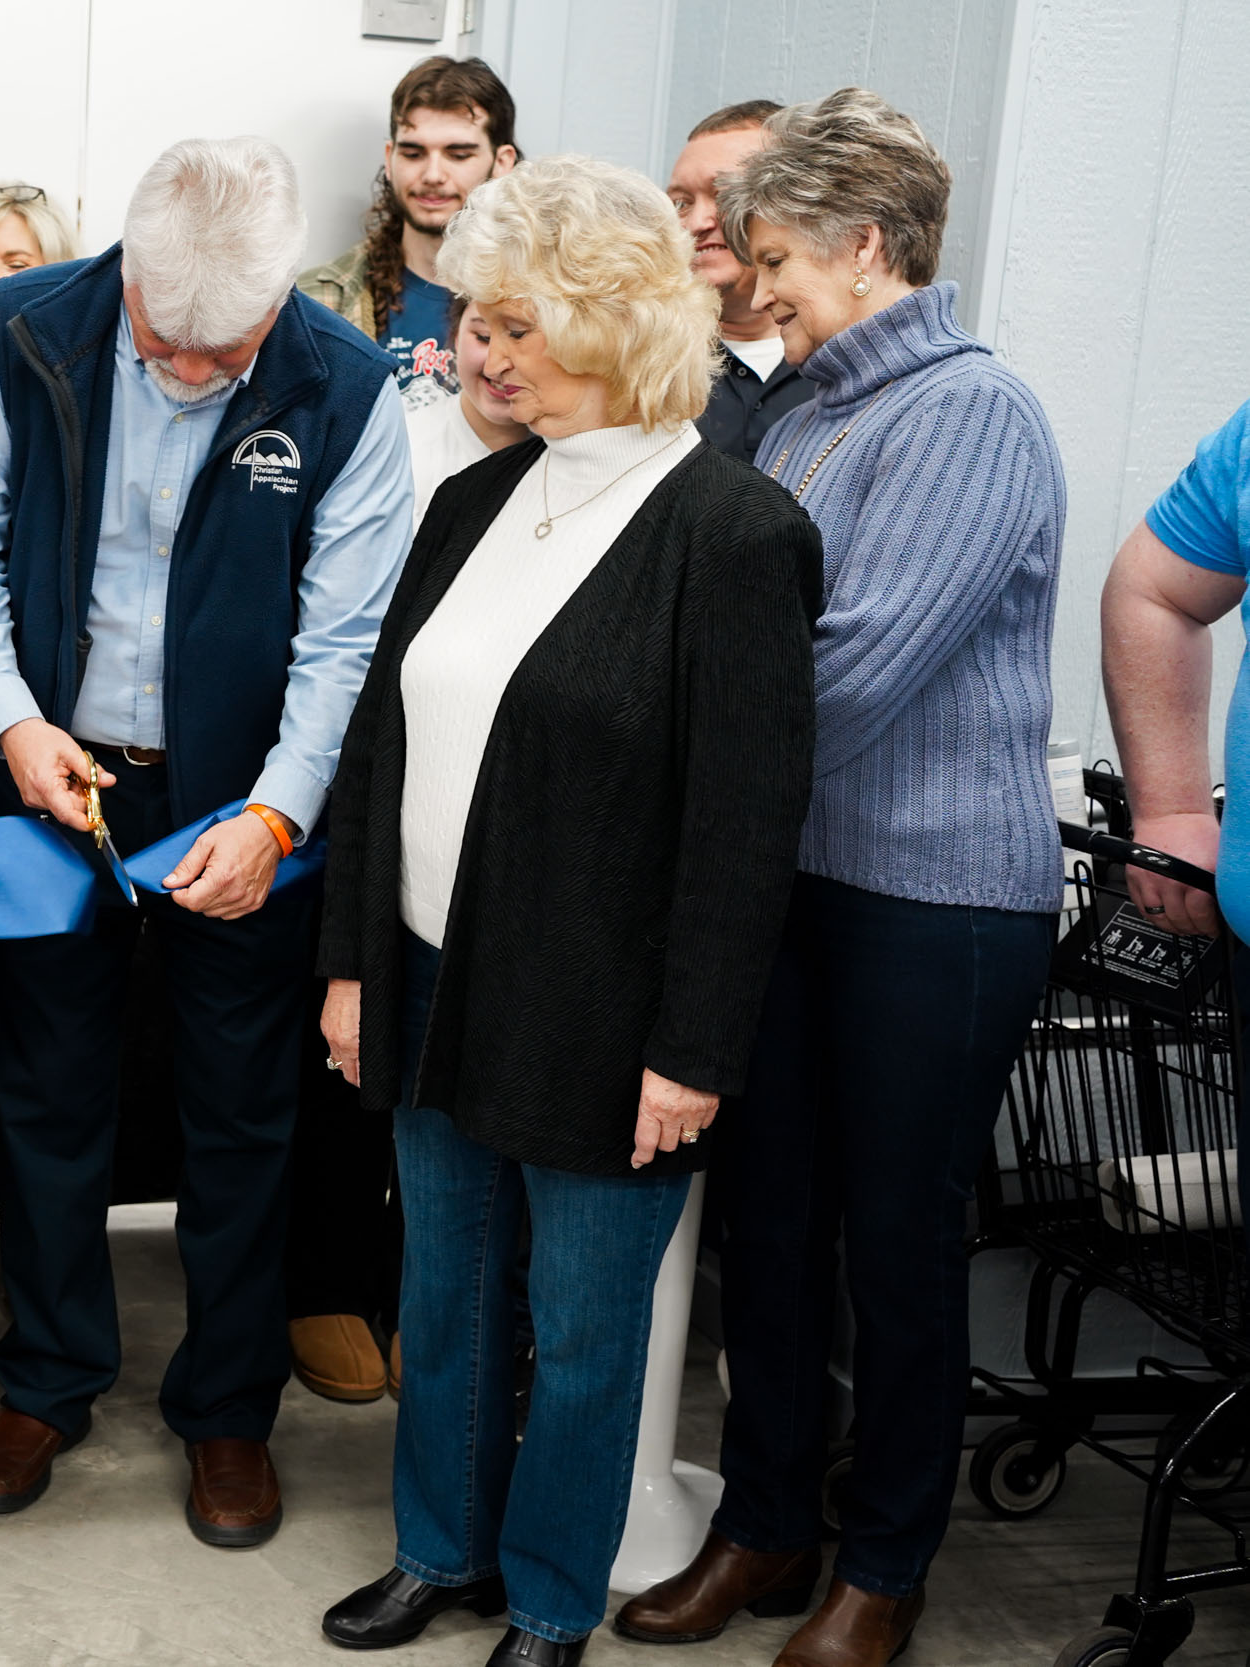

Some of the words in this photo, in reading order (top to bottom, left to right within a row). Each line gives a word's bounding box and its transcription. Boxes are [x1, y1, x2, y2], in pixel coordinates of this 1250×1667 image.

[254, 465, 283, 475] Christian
[253, 474, 298, 485] Appalachian
[273, 483, 298, 493] Project
